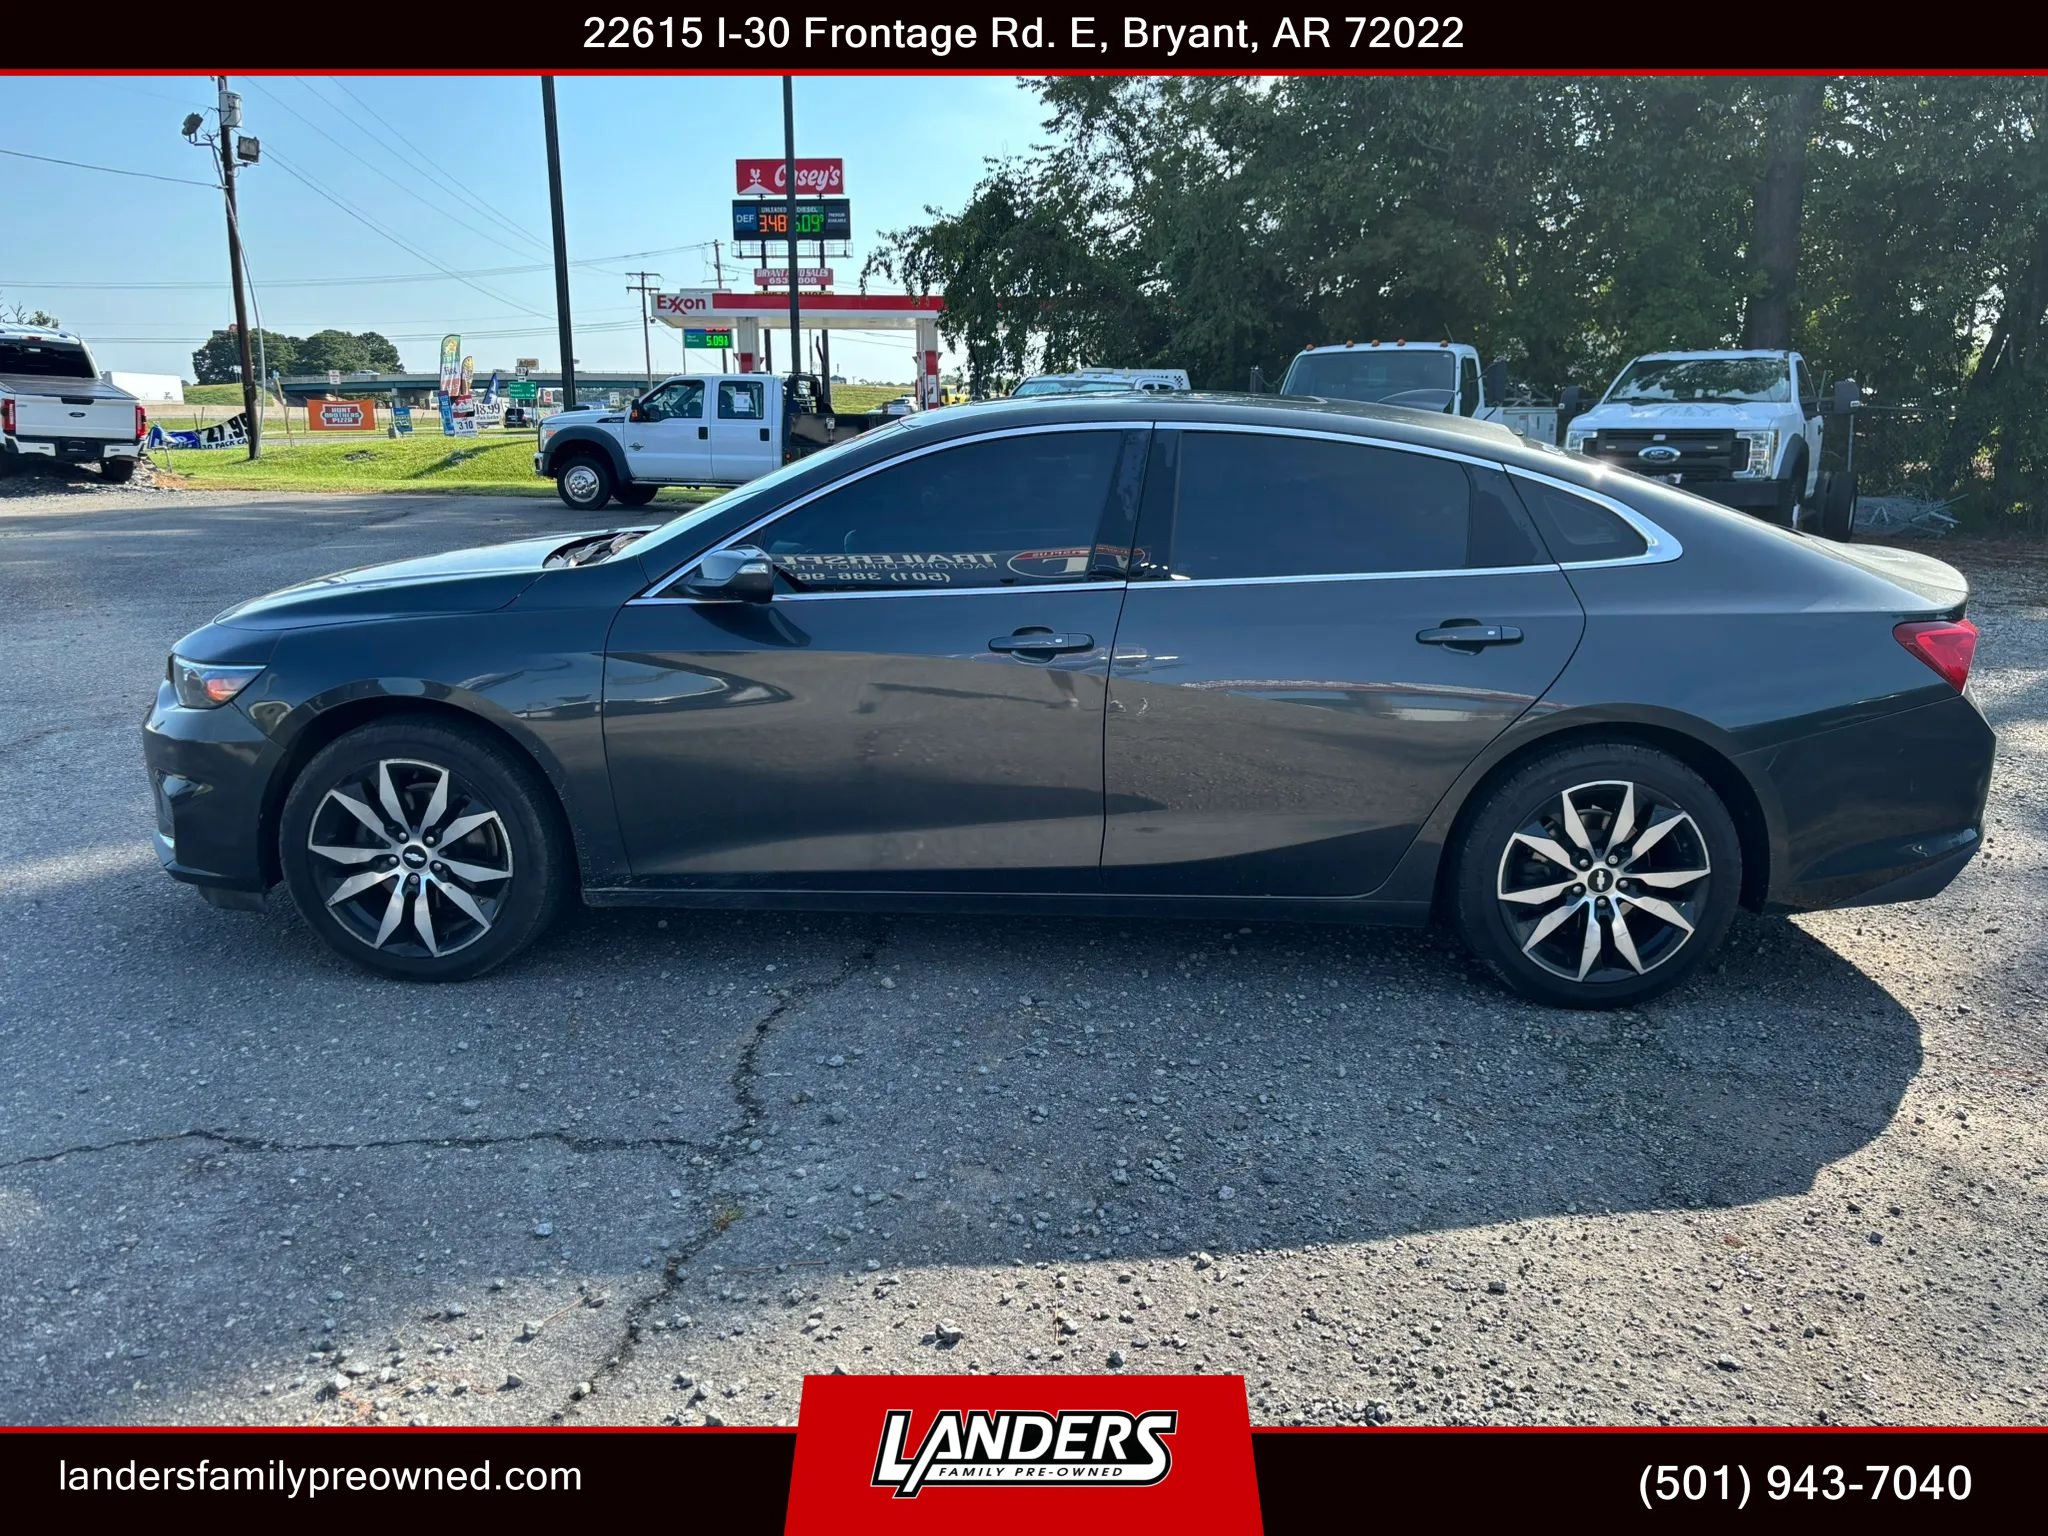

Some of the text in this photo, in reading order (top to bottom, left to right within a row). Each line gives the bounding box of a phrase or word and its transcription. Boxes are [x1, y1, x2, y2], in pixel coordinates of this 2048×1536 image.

[774, 164, 841, 192] Csey's
[736, 214, 755, 223] DEF
[806, 268, 829, 277] SALES
[657, 294, 706, 315] Exxon
[215, 441, 235, 449] PACK
